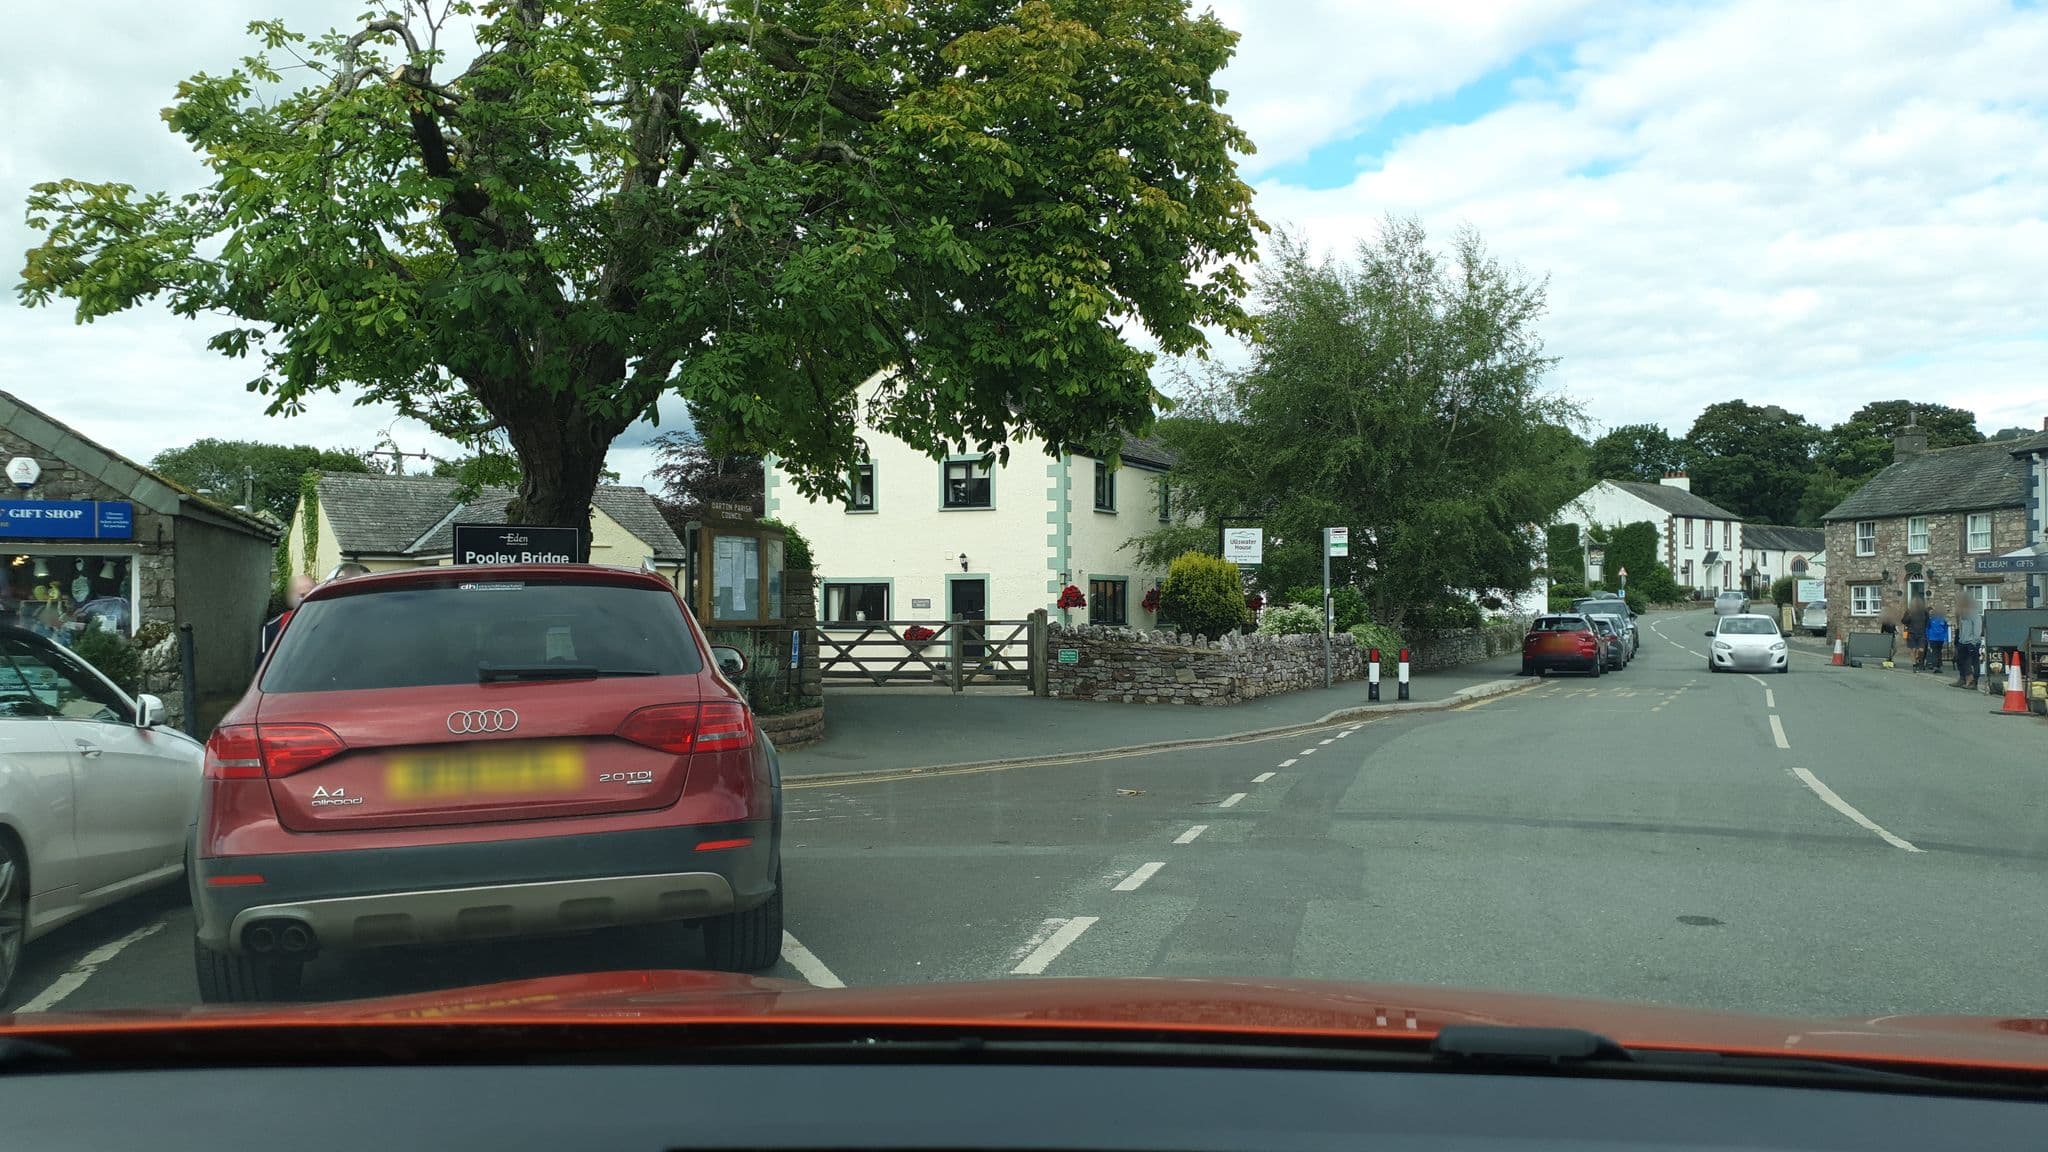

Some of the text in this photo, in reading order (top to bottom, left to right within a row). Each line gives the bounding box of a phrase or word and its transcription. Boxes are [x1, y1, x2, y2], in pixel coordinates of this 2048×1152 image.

[8, 508, 44, 518] GIFT
[45, 509, 83, 519] SHOP
[506, 533, 529, 543] Eden
[465, 551, 570, 564] Pooley Bridge
[2016, 560, 2034, 568] GIFTS
[1989, 652, 2003, 660] ICE
[312, 785, 345, 799] A4
[311, 796, 363, 807] allroad
